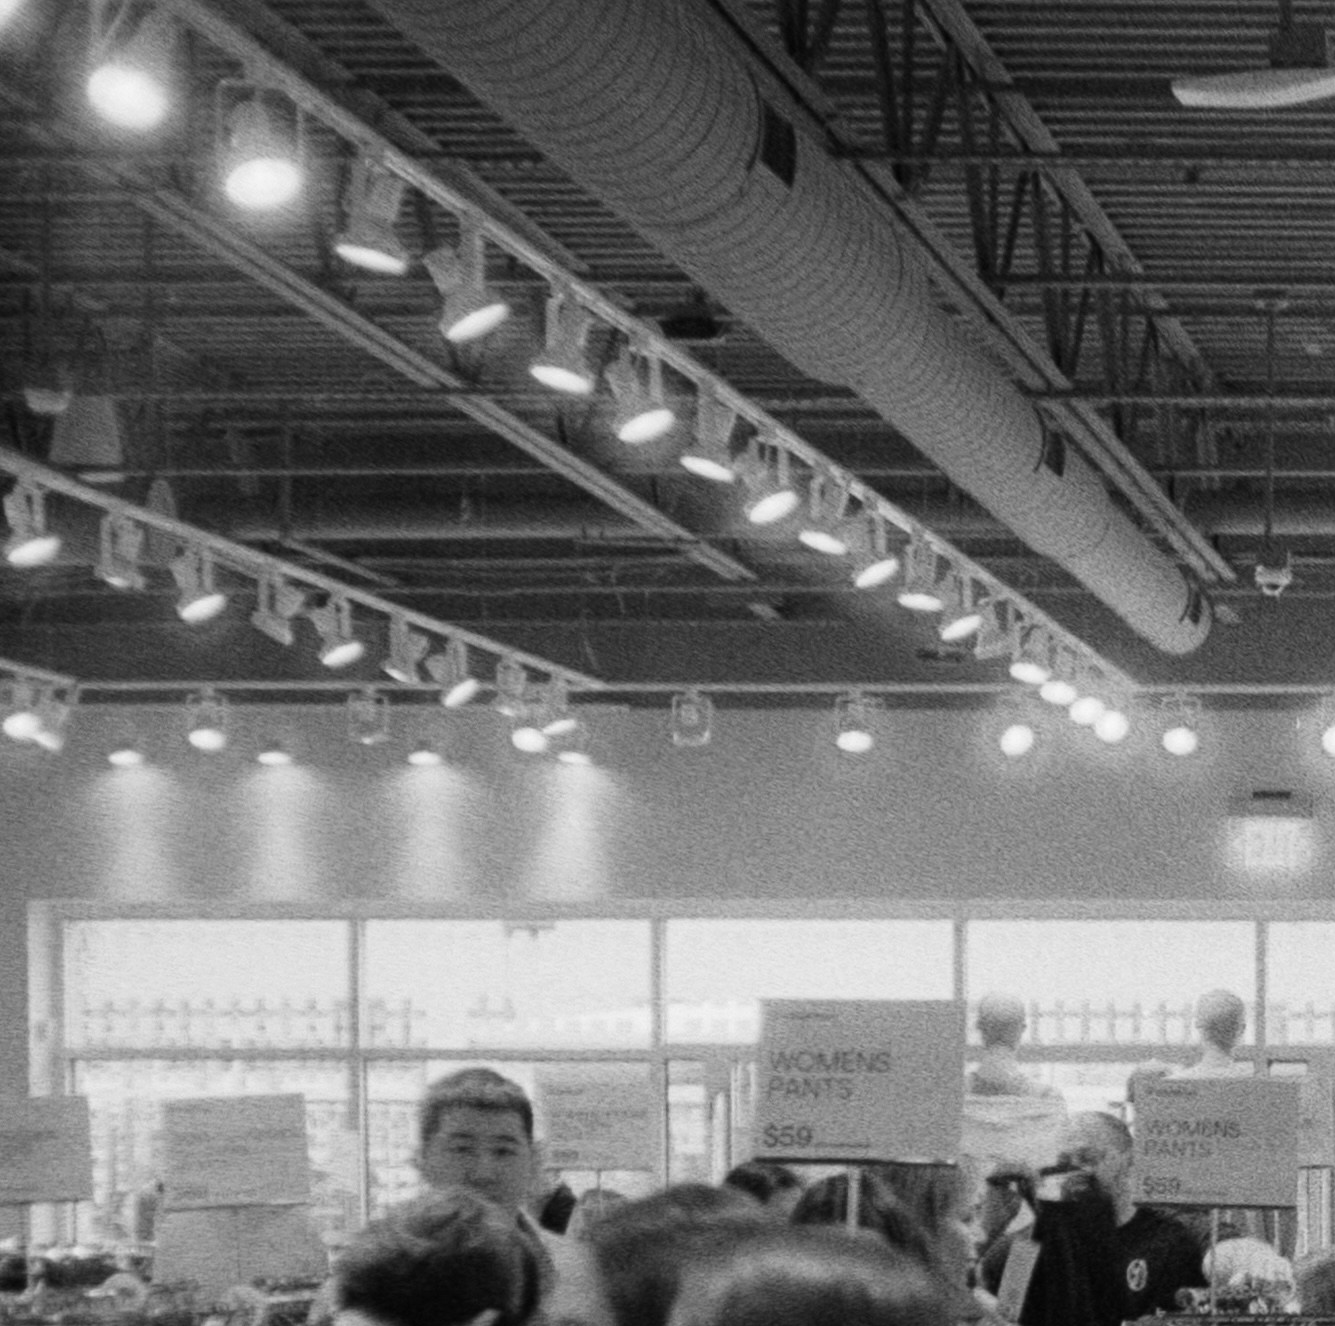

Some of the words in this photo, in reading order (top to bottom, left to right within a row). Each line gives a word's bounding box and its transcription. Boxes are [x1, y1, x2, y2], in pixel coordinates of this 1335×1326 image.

[768, 1049, 893, 1074] WOMENS
[767, 1075, 854, 1100] PANTS
[762, 1122, 814, 1148] $59
[1145, 1119, 1242, 1139] WOMENS
[1143, 1139, 1213, 1157] PANTS
[1142, 1175, 1181, 1196] $59
